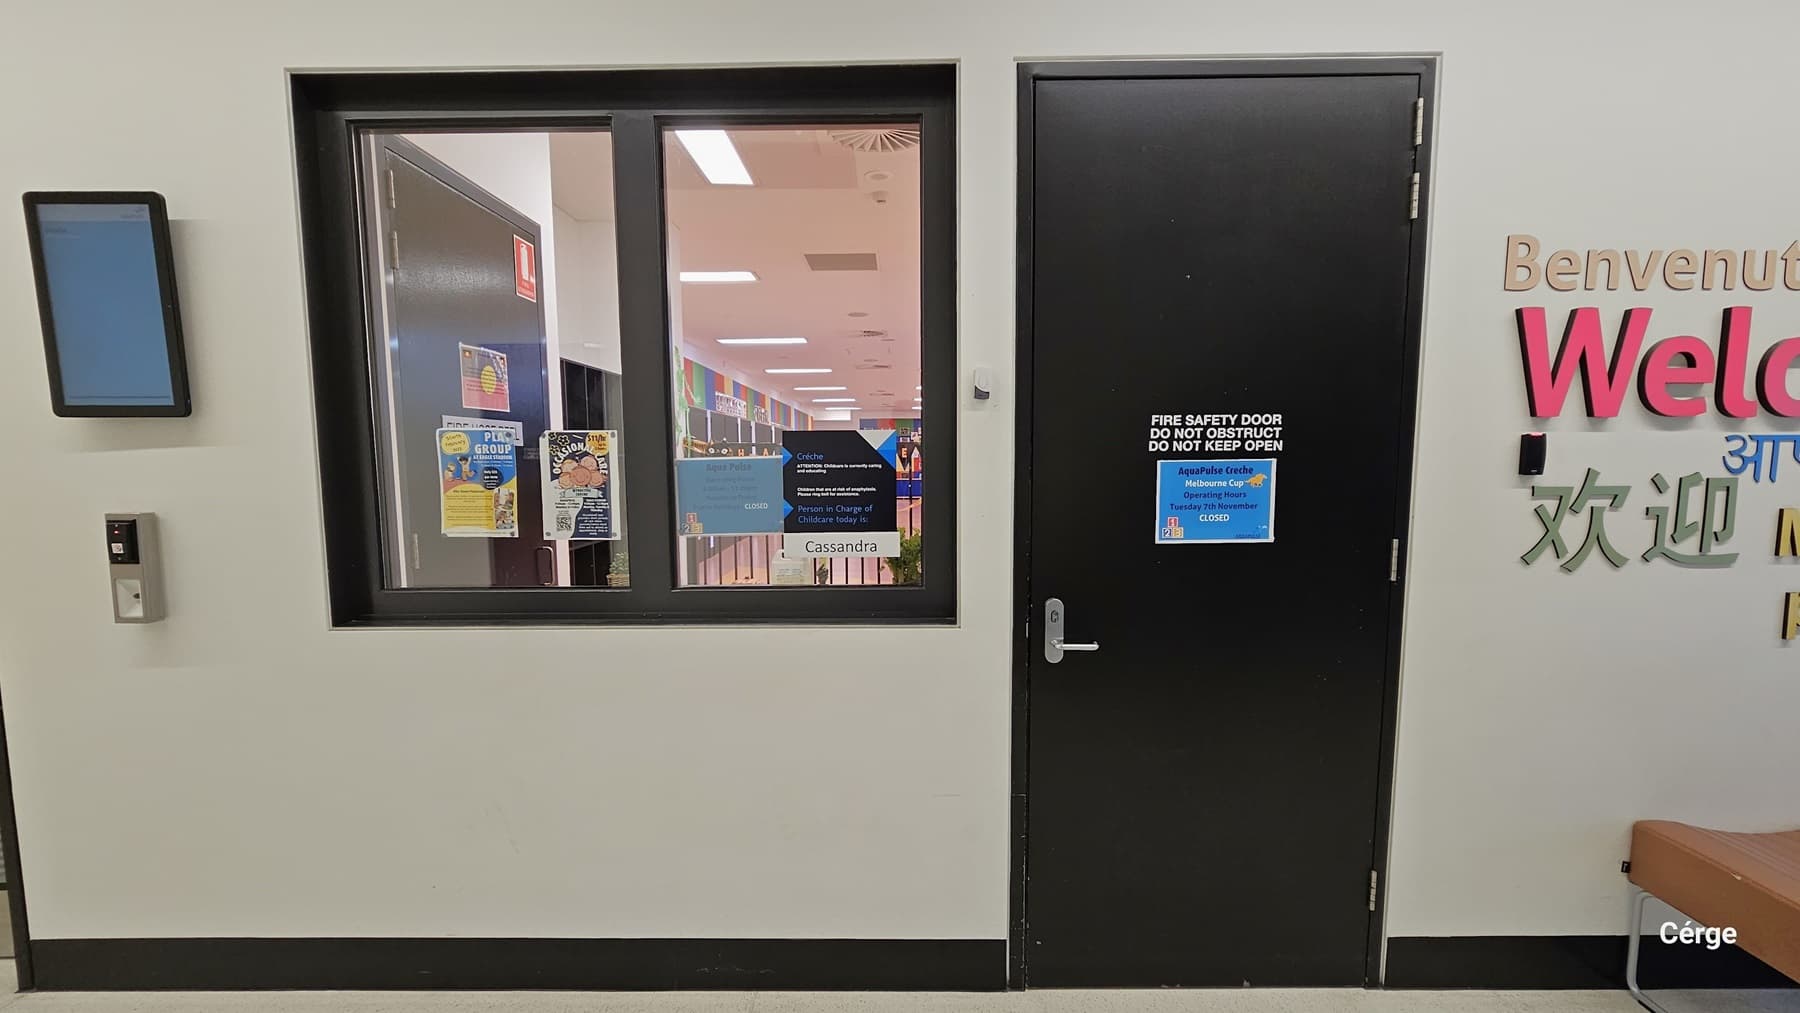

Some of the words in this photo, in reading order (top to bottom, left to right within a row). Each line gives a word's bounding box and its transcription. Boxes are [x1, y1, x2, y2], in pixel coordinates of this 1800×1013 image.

[1151, 414, 1182, 426] FIRE
[1185, 414, 1238, 426] SAFETY
[1241, 414, 1282, 426] DOOR
[1150, 427, 1171, 439] DO
[1174, 427, 1203, 439] NOT
[1206, 427, 1282, 439] OBSTRUCT
[474, 444, 512, 454] GROUP
[1148, 440, 1169, 452] DO
[1172, 440, 1202, 452] NOT
[1204, 440, 1241, 452] KEEP
[1244, 440, 1283, 452] OPEN
[796, 452, 824, 460] Créche
[1178, 465, 1223, 477] AquaPulse
[1225, 465, 1254, 475] Creche
[1185, 479, 1227, 488] Melbourne
[1229, 479, 1244, 488] Cup
[1183, 491, 1222, 499] Operating
[744, 502, 769, 510] CLOSED
[835, 504, 862, 514] Charge
[864, 504, 873, 512] of
[1170, 503, 1202, 511] Tuesday
[1217, 502, 1258, 510] November
[798, 515, 834, 523] Childcare
[836, 515, 857, 525] today
[1199, 514, 1230, 522] CLOSED
[1519, 467, 1740, 573] 欢迎
[805, 540, 878, 553] Cassandra
